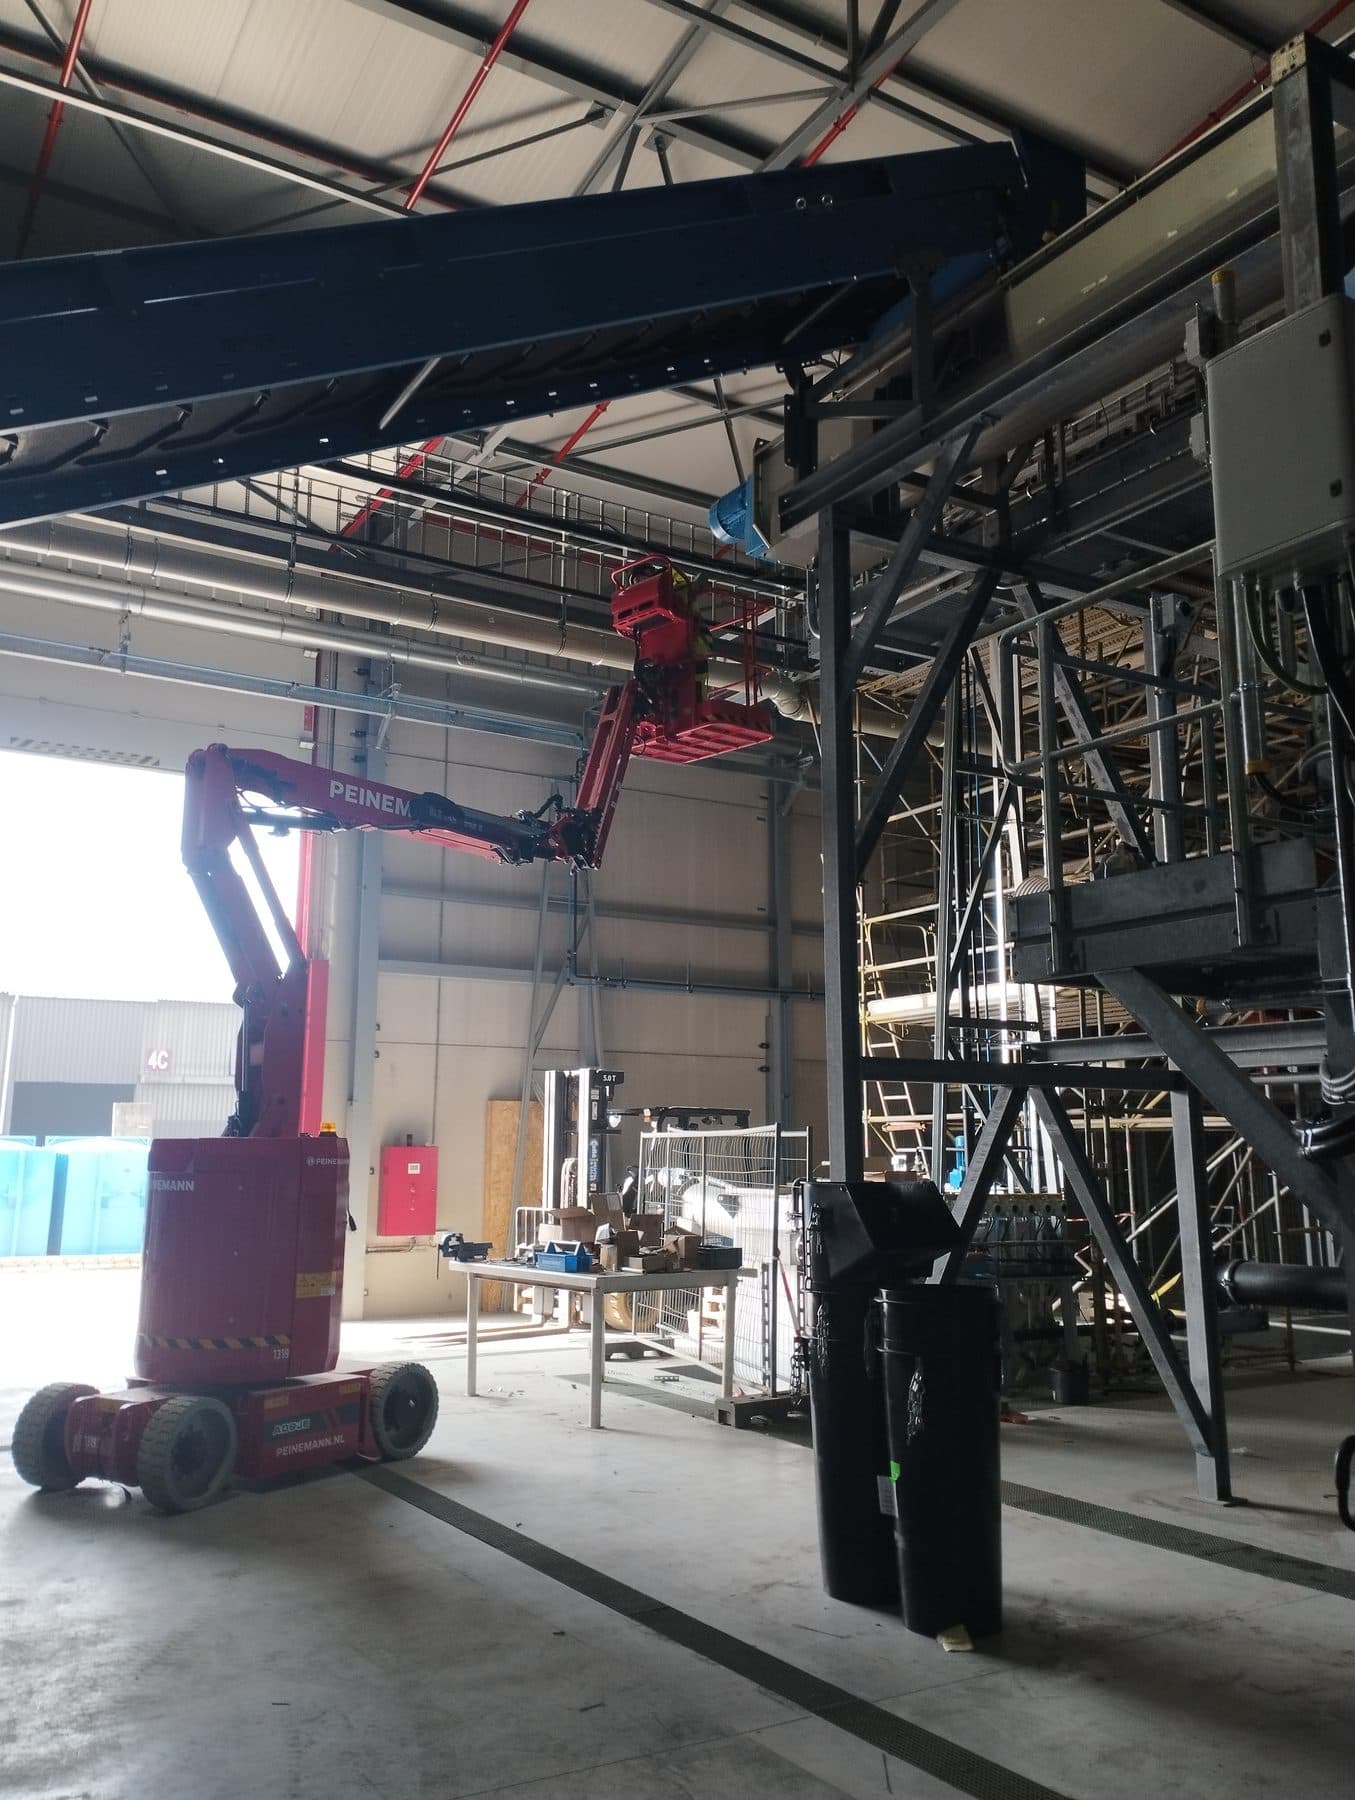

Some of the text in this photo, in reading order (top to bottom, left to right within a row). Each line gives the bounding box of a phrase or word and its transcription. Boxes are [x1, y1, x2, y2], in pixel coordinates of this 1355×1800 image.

[329, 779, 412, 818] PEINEM
[147, 1050, 169, 1070] 4C
[275, 1434, 345, 1457] PEINEMANN.NL
